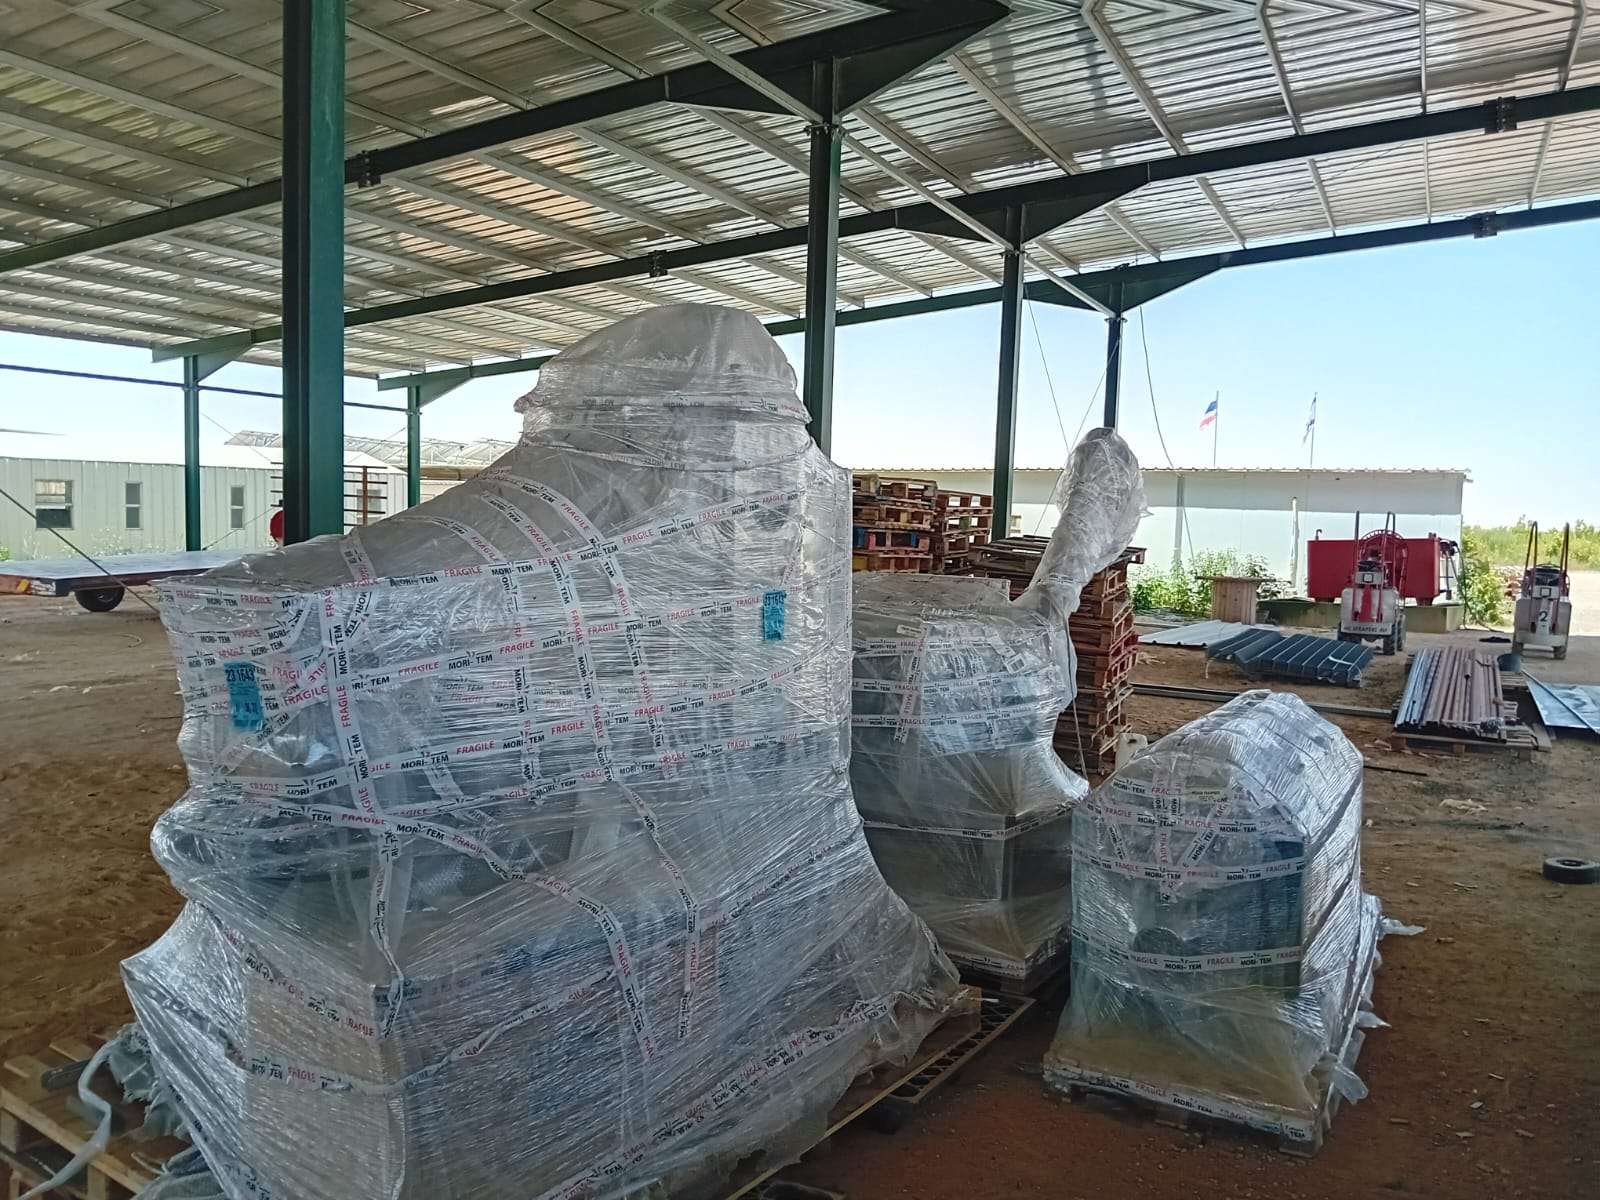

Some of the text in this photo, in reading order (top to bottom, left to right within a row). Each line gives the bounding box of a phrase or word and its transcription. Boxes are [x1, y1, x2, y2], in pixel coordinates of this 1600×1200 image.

[561, 503, 590, 531] FRAGILE
[444, 566, 483, 578] FRAGILE
[622, 529, 654, 545] FRAGILE
[526, 525, 552, 553] FRAGILE
[616, 583, 632, 617] FRAGILE
[570, 609, 586, 648] FRAGILE
[588, 624, 620, 637] FRAGILE
[667, 608, 696, 621] FRAGILE
[1538, 610, 1549, 623] 2
[398, 660, 440, 676] FRAGILE
[500, 640, 536, 654] FRAGILE
[283, 684, 330, 707] FRAGILE
[336, 684, 352, 729] FRAGILE
[456, 740, 497, 755] FRAGILE
[551, 720, 586, 736] FRAGILE
[634, 704, 666, 718] FRAGILE
[708, 689, 737, 703] FRAGILE
[341, 813, 387, 826] FRAGILE
